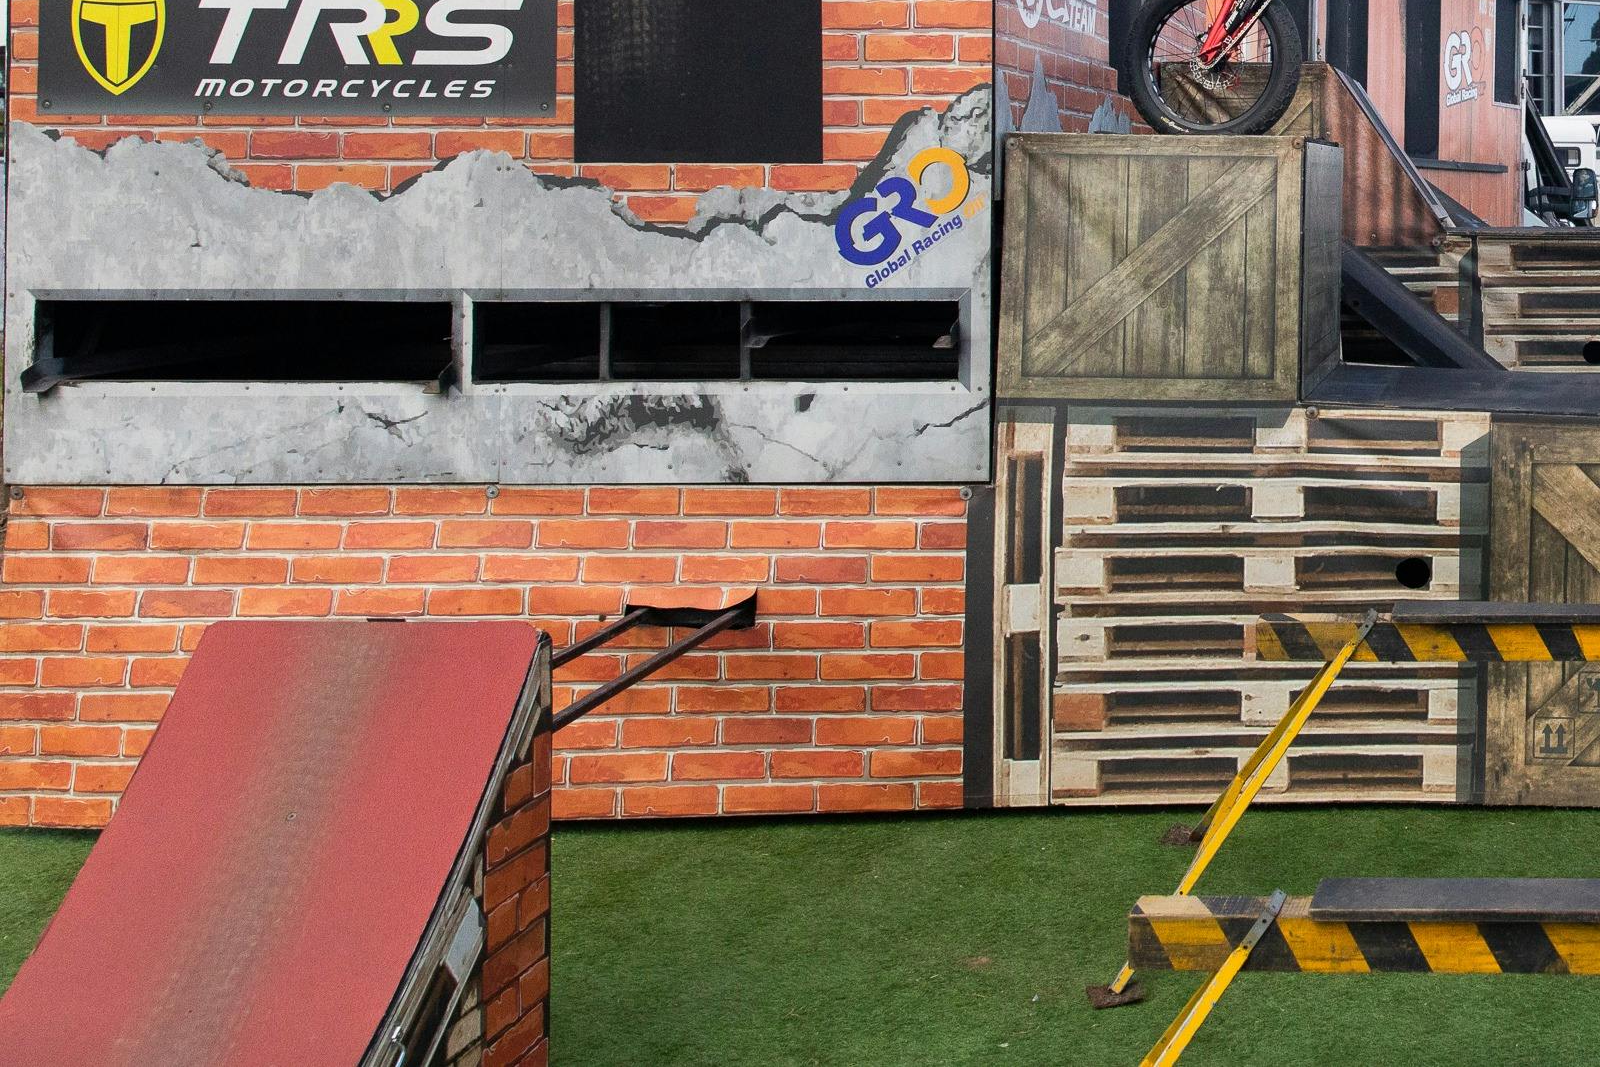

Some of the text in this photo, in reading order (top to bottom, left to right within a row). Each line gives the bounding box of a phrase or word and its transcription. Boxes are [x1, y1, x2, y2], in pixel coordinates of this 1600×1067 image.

[1067, 0, 1097, 36] TEAM
[194, 78, 496, 98] MOTORCYCLES
[865, 249, 912, 289] Global
[911, 214, 963, 256] Racing
